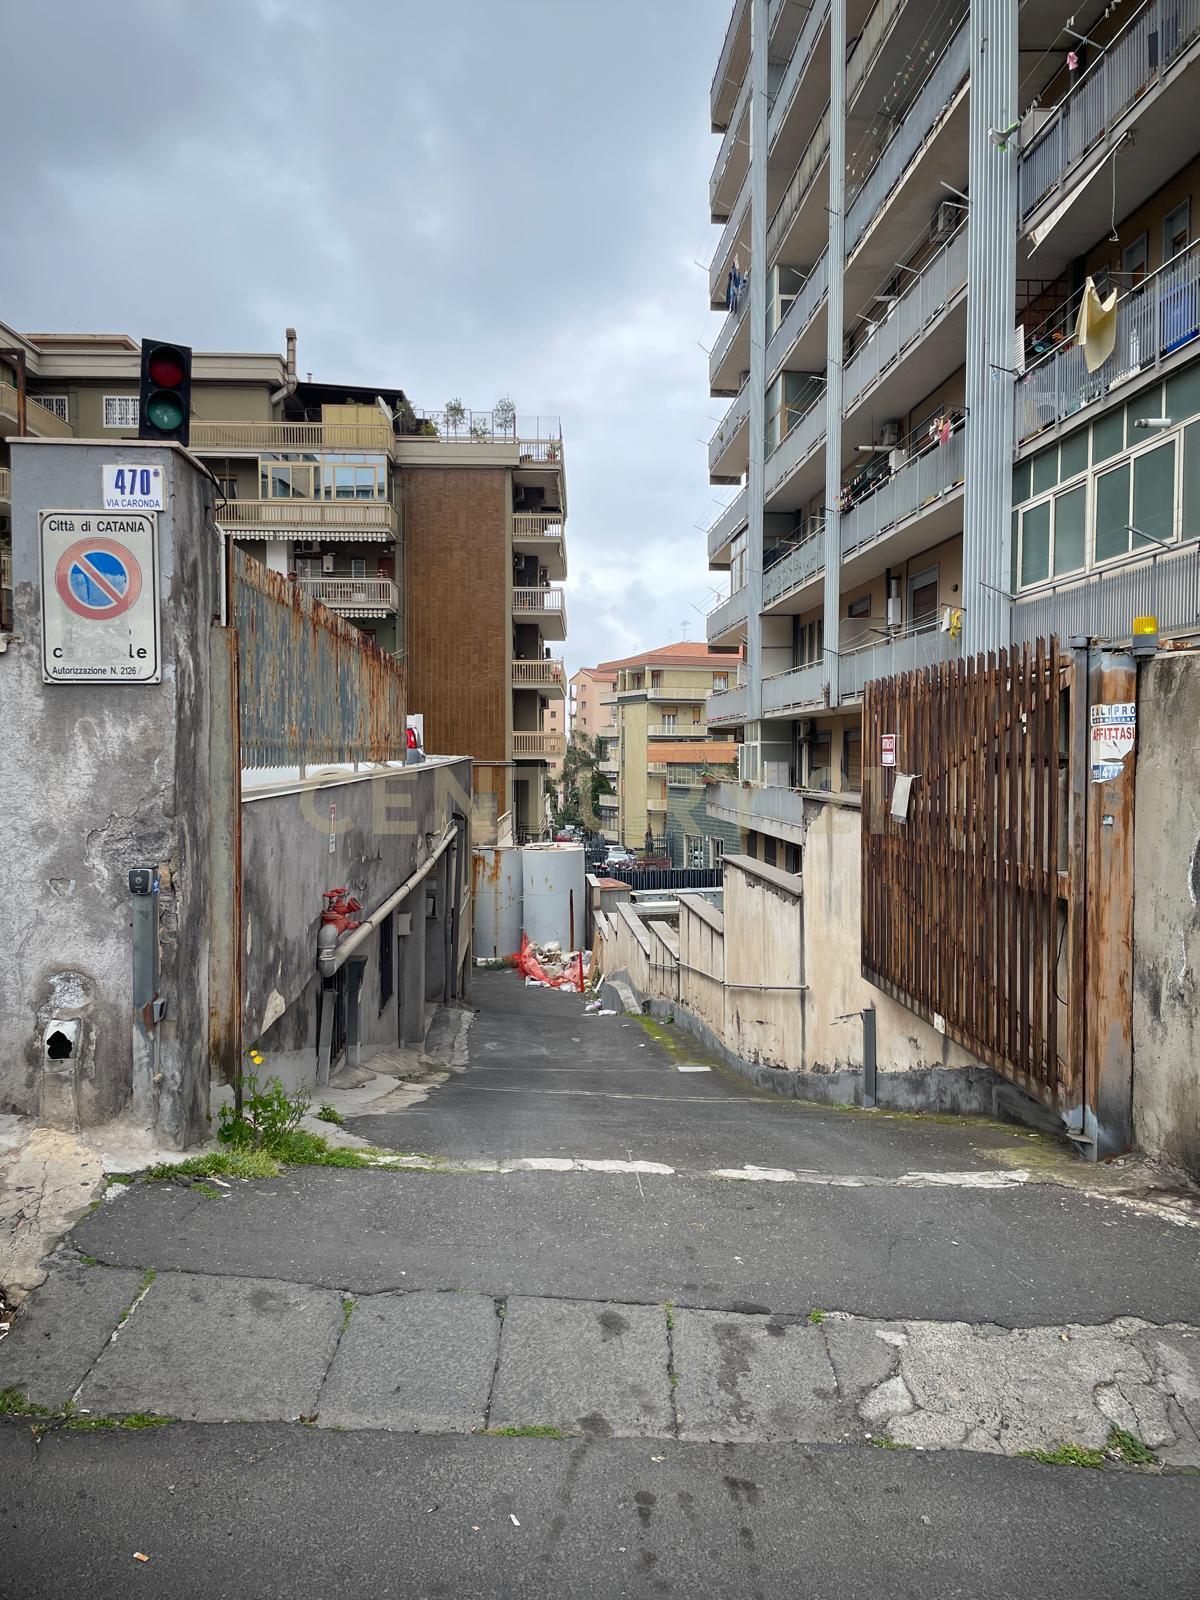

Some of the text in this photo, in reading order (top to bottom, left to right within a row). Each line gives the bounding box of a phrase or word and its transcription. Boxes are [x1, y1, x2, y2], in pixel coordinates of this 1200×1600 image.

[114, 469, 151, 496] 470
[106, 499, 160, 508] VIA CARONDA
[49, 520, 145, 533] Città di CATANIA
[52, 666, 107, 675] Autorizzazione
[110, 666, 118, 675] N.
[120, 666, 137, 675] 2126
[1092, 727, 1135, 741] AFFITTASI
